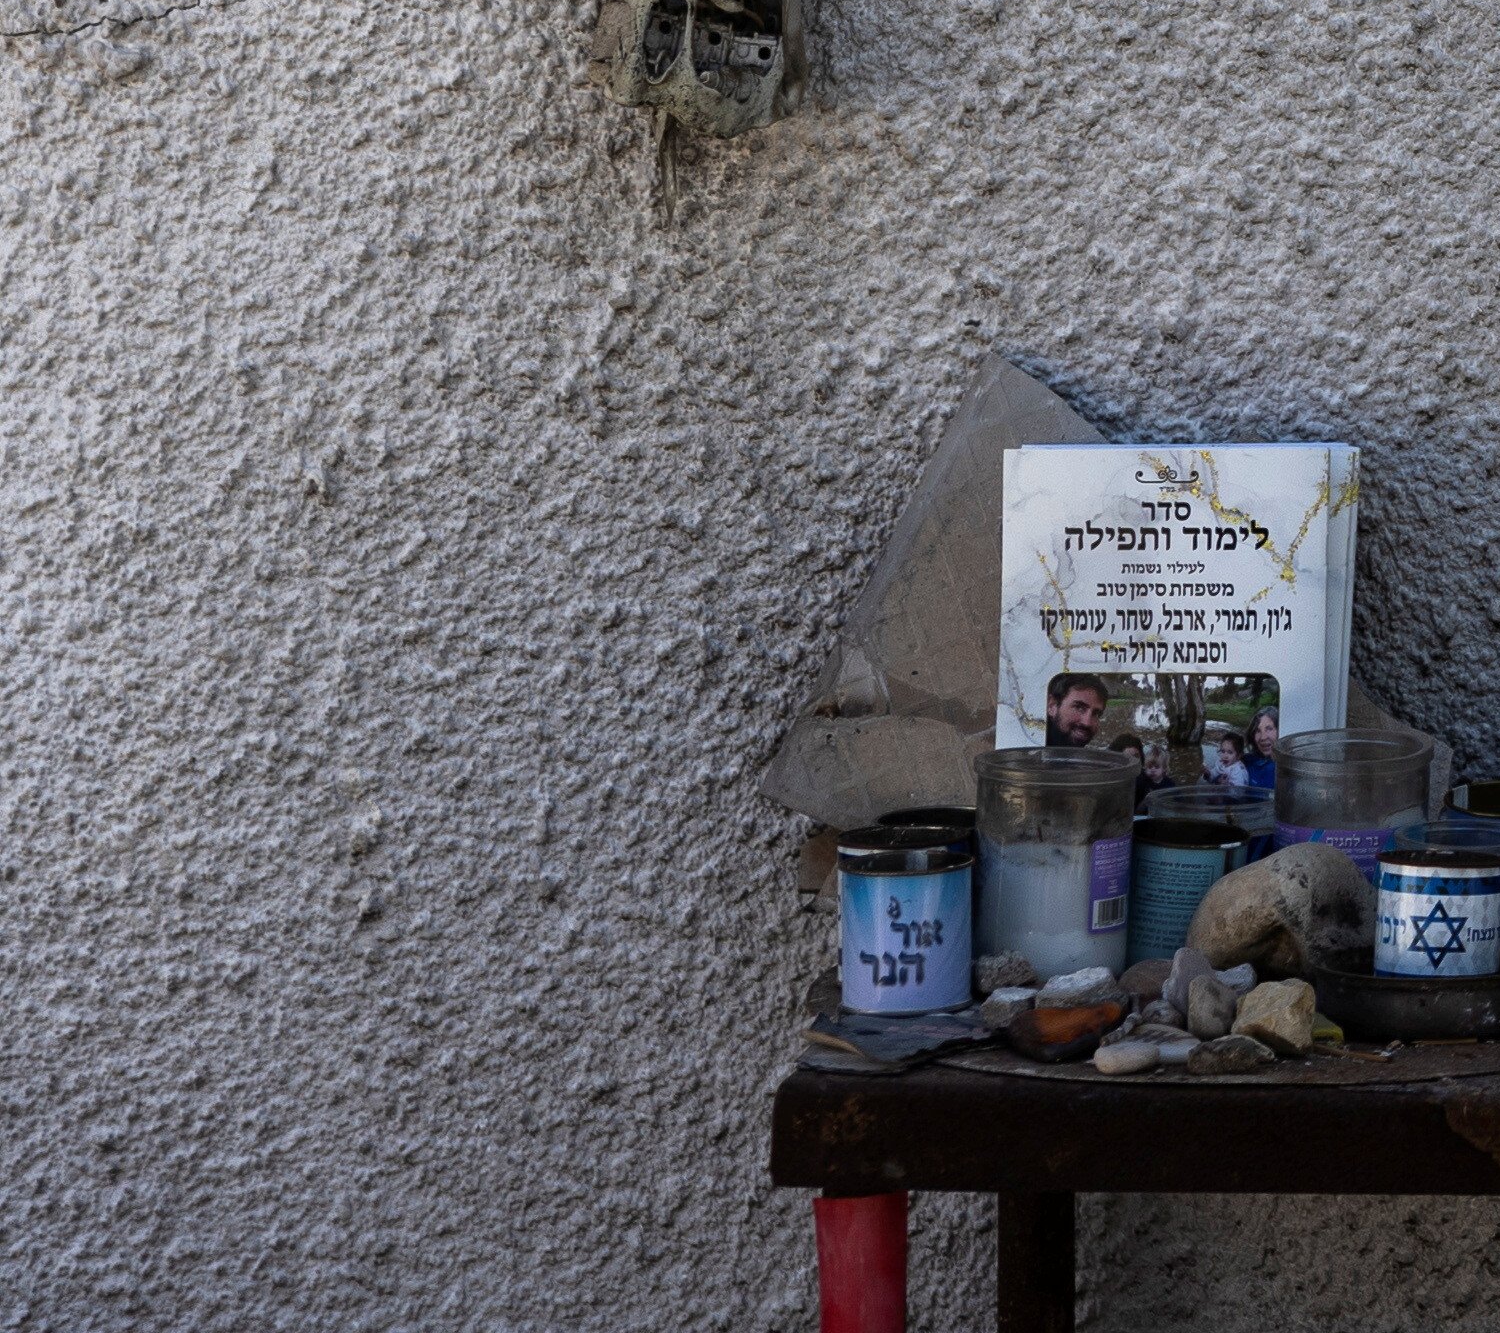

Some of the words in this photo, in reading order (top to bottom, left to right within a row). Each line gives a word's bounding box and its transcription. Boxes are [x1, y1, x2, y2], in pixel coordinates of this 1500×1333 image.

[1141, 501, 1192, 522] סדר
[1064, 520, 1171, 551] ותפילה
[1182, 520, 1270, 551] לימוד
[1121, 563, 1162, 574] נשמות
[1166, 561, 1206, 574] לעילוי
[1096, 583, 1129, 597] טוב
[1129, 583, 1168, 601] סימן
[1170, 583, 1235, 597] משפחת
[1039, 608, 1107, 637] עומריקו
[1111, 609, 1153, 635] שחר,
[1157, 603, 1206, 635] ארבל,
[1210, 609, 1258, 635] תמרי,
[1128, 635, 1169, 669] קרול
[1173, 641, 1228, 664] וסבתא
[890, 918, 944, 949] אור
[859, 950, 925, 987] הנר
